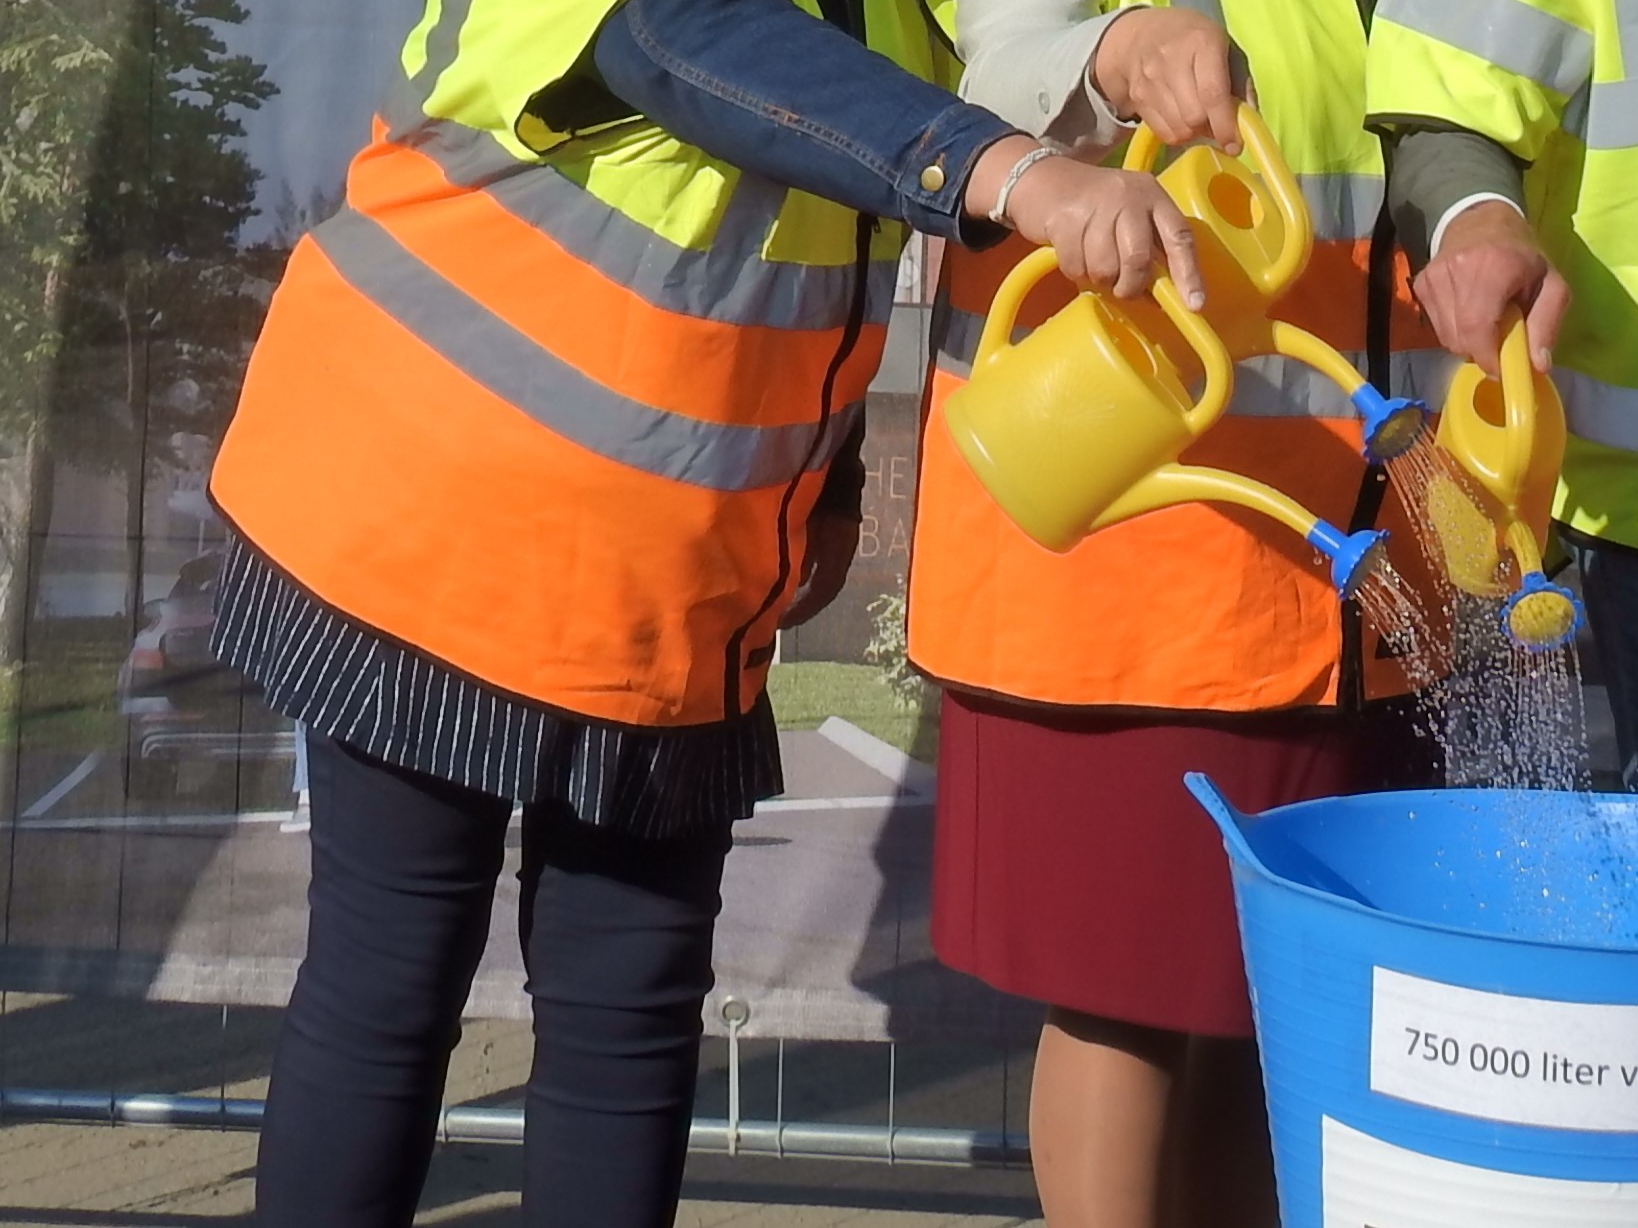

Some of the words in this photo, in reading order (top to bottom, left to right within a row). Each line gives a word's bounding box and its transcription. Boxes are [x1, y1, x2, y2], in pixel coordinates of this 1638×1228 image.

[1403, 1026, 1460, 1067] 750
[1468, 1042, 1531, 1079] 000
[1541, 1051, 1611, 1087] liter
